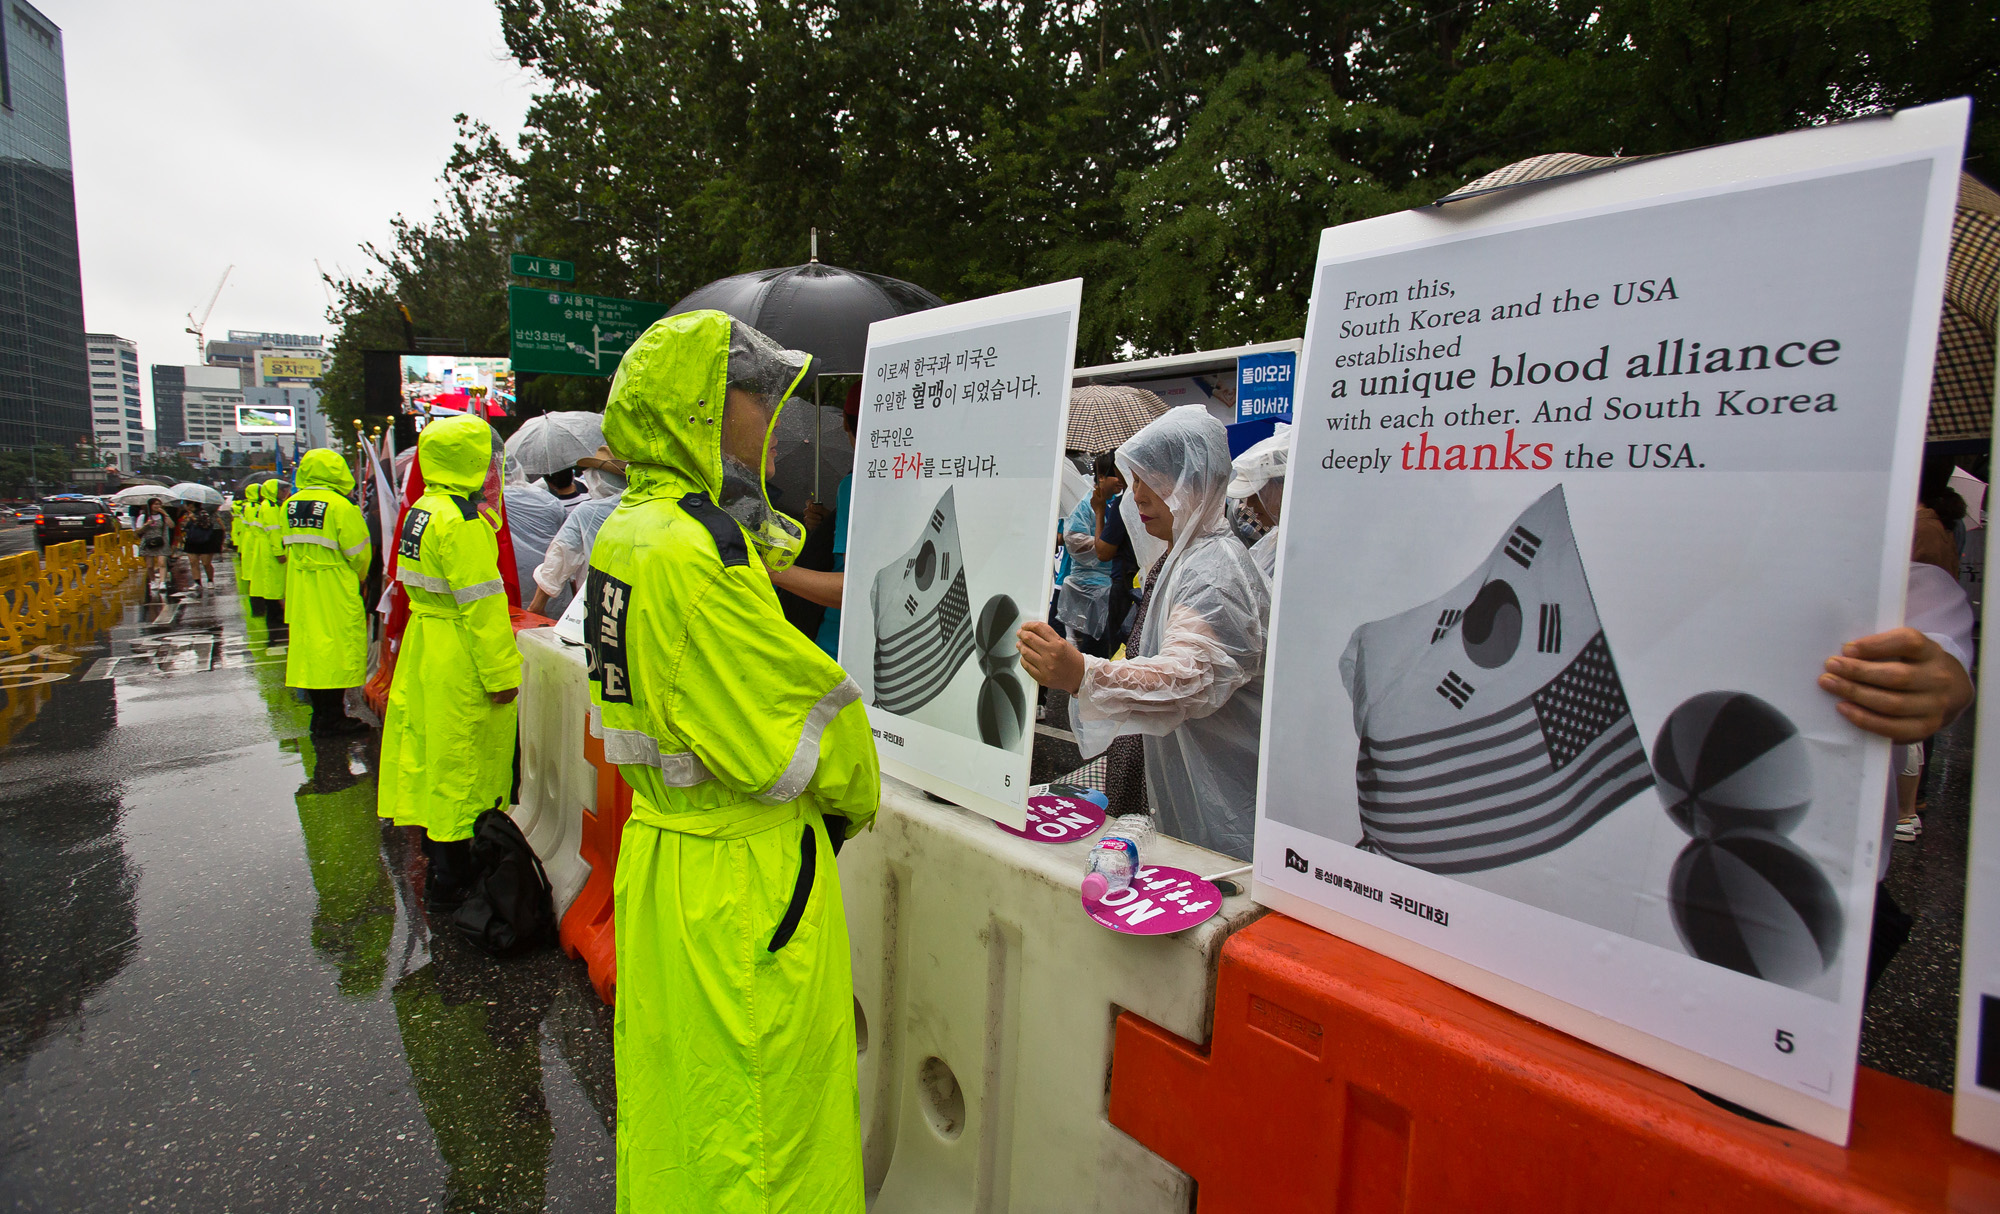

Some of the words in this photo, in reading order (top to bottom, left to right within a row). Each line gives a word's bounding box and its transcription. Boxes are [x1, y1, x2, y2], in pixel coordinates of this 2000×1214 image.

[528, 261, 560, 276] 시청
[564, 295, 594, 307] 서울역
[1340, 313, 1399, 338] South
[1409, 309, 1481, 330] Korea
[1491, 293, 1541, 320] and
[1553, 289, 1599, 313] the
[1614, 277, 1679, 305] USA
[1344, 290, 1398, 310] From
[1408, 279, 1455, 300] this,
[564, 309, 594, 321] 숭례문
[515, 329, 566, 343] 남산3호터널
[878, 360, 909, 382] 이로써
[914, 353, 951, 377] 한국과
[957, 347, 997, 371] 미국은
[1336, 335, 1461, 368] established
[1242, 364, 1291, 385] 돌아오라
[1331, 380, 1347, 398] a
[1360, 368, 1475, 398] unique
[1490, 345, 1609, 388] blood
[1626, 338, 1841, 378] alliance
[874, 390, 906, 412] 유일한
[912, 380, 956, 409] 혈맹이
[962, 375, 1040, 403] 되었습니다.
[1241, 397, 1289, 416] 돌아서라
[1327, 409, 1371, 430] with
[1380, 406, 1433, 428] each
[1445, 403, 1520, 426] other.
[1532, 397, 1592, 423] And
[1604, 391, 1701, 420] South
[1716, 390, 1838, 416] Korea
[871, 428, 914, 448] 한국인은
[1322, 448, 1392, 473] deeply
[1401, 428, 1553, 470] thanks
[1565, 443, 1614, 468] the
[1628, 443, 1705, 468] USA.
[868, 459, 888, 478] 깊은
[892, 453, 935, 479] 감사를
[939, 455, 998, 478] 드립니다.
[405, 510, 429, 537] 찰
[1005, 775, 1010, 787] 5
[1036, 812, 1094, 837] NO
[1099, 886, 1166, 926] NO
[1315, 868, 1383, 903] 동성애축제반대
[1390, 893, 1448, 926] 국민대회
[1775, 1029, 1794, 1053] 5
